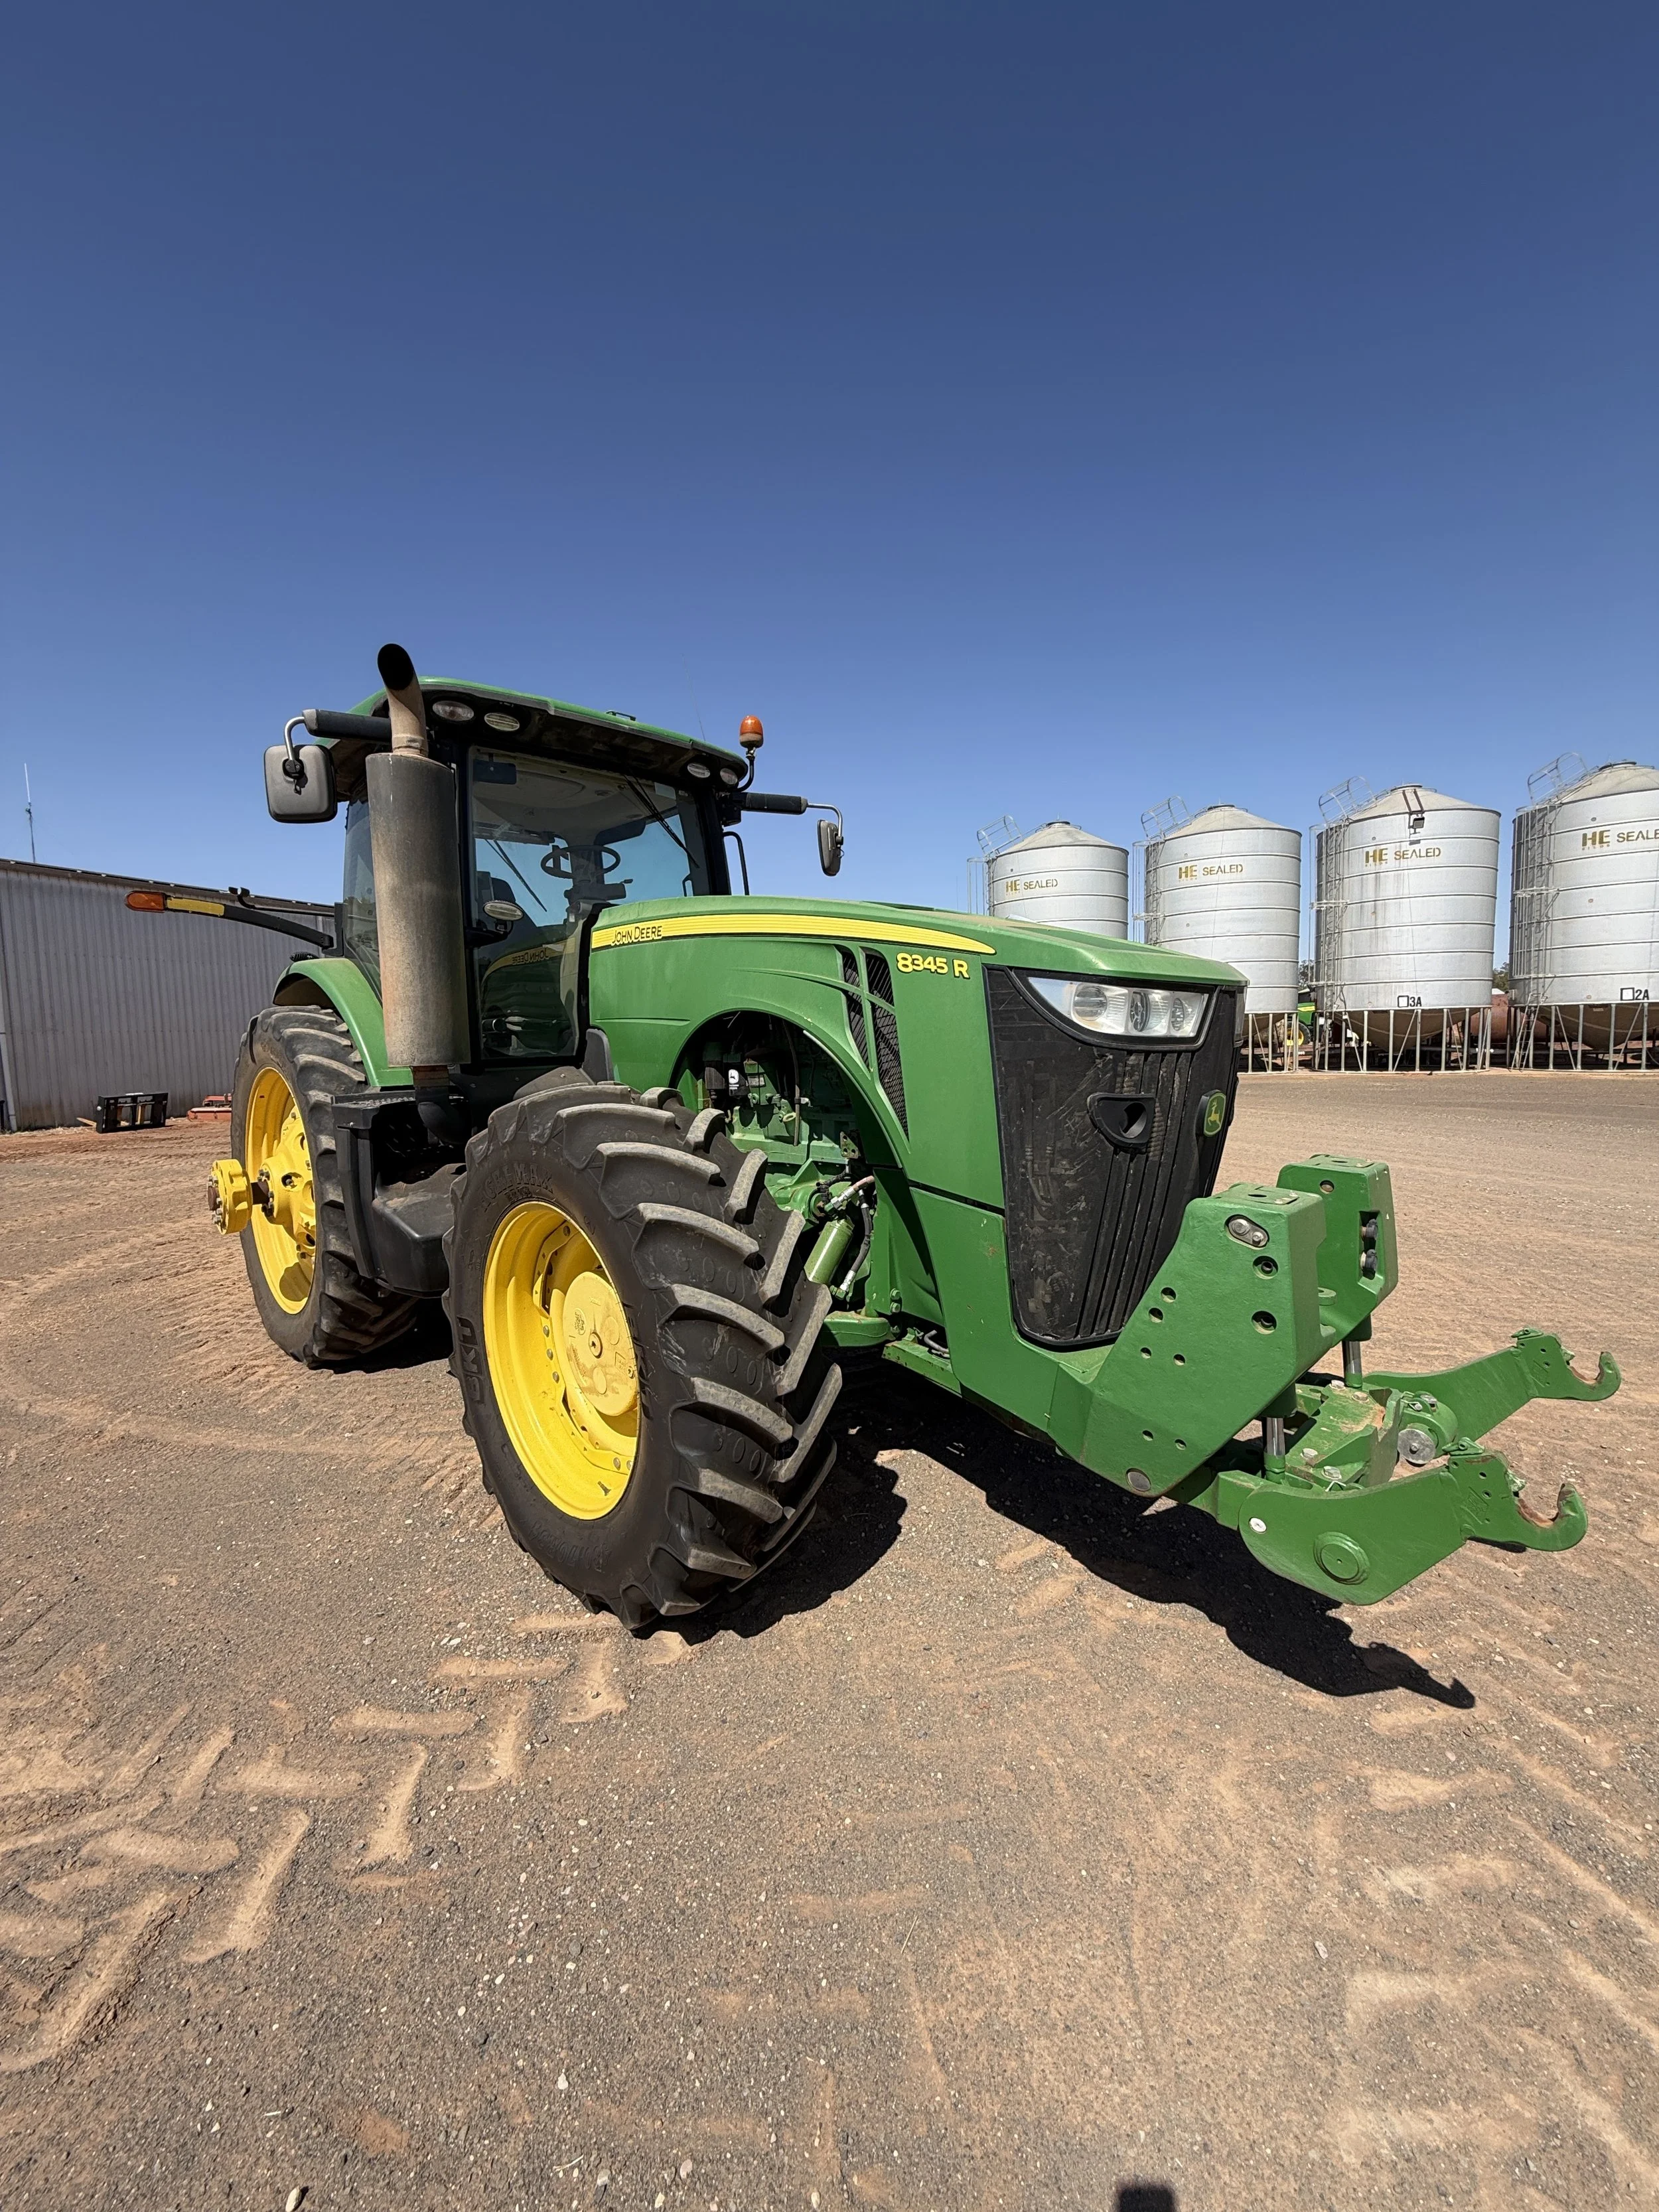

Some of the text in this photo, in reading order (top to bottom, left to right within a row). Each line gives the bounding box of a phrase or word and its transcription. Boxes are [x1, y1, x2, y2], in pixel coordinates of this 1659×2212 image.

[1581, 830, 1611, 846] HE
[1365, 848, 1441, 863] HE SEALED
[1179, 864, 1243, 879] HE SEALED
[1006, 879, 1058, 893] HE SEALED
[612, 926, 662, 944] JOHN DEERE
[897, 952, 970, 979] 8345 R
[1409, 996, 1422, 1007] 3A
[1635, 989, 1650, 1000] 2A
[457, 1315, 485, 1405] BKT
